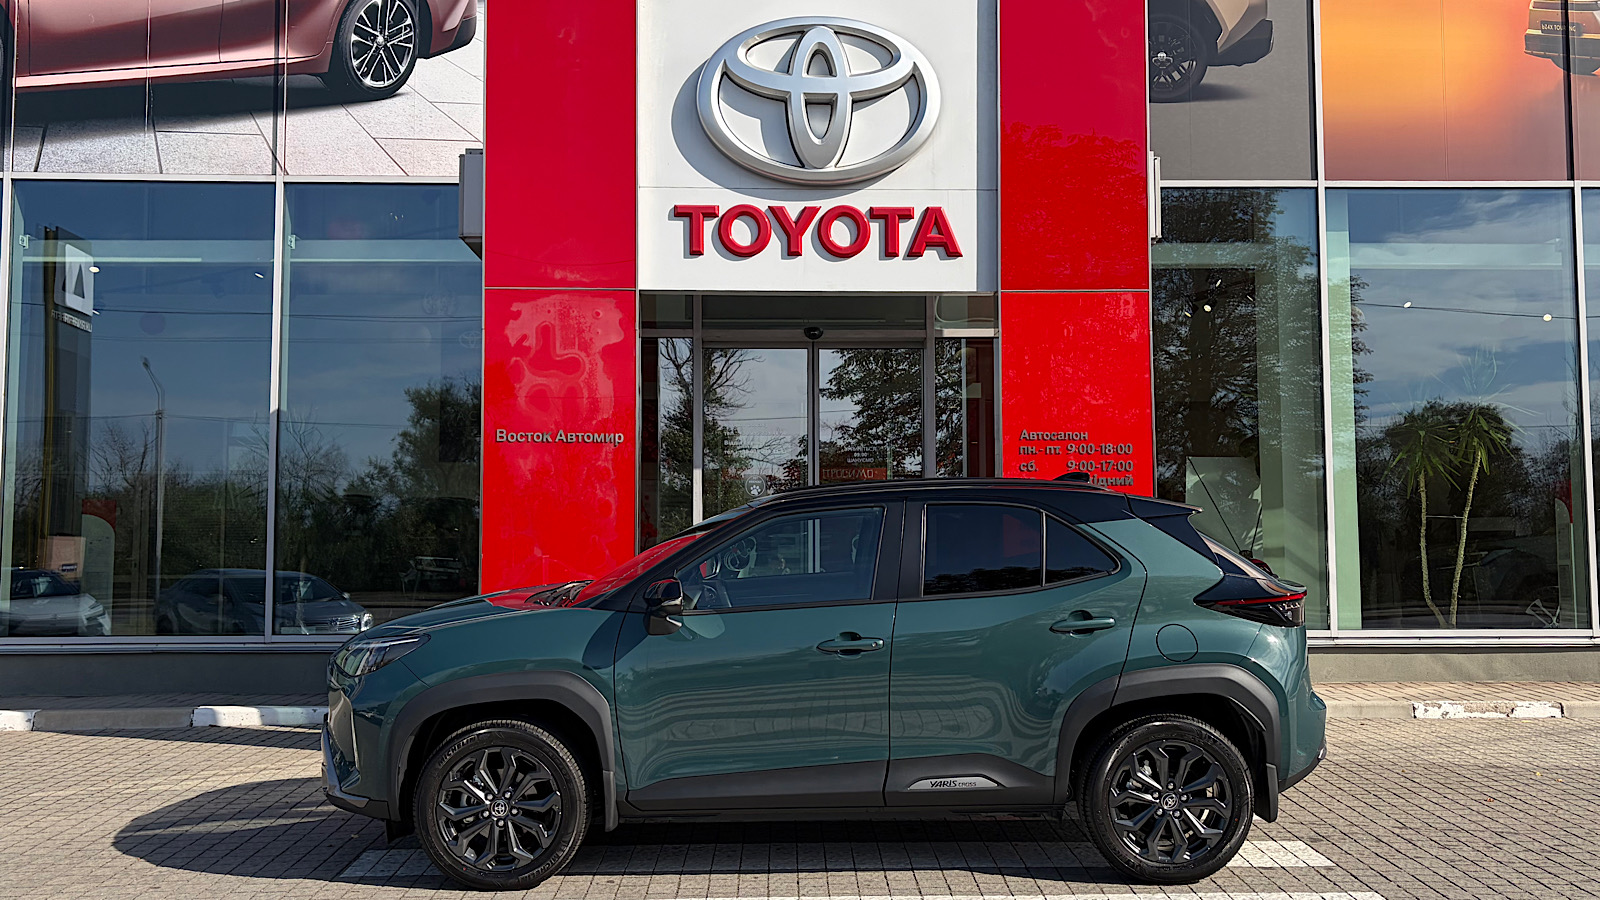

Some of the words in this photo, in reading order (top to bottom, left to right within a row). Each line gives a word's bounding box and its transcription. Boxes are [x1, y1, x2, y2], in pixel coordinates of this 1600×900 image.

[674, 203, 963, 258] TOYOTA
[496, 429, 552, 442] Восток
[555, 429, 624, 447] Автомир
[1020, 429, 1088, 441] Автосалон
[1067, 443, 1133, 455] 9:00-18:00
[1020, 460, 1039, 472] сб.
[1067, 460, 1134, 472] 9:00-17:00
[822, 468, 874, 479] ПРОСИМО
[930, 780, 957, 788] YARIS
